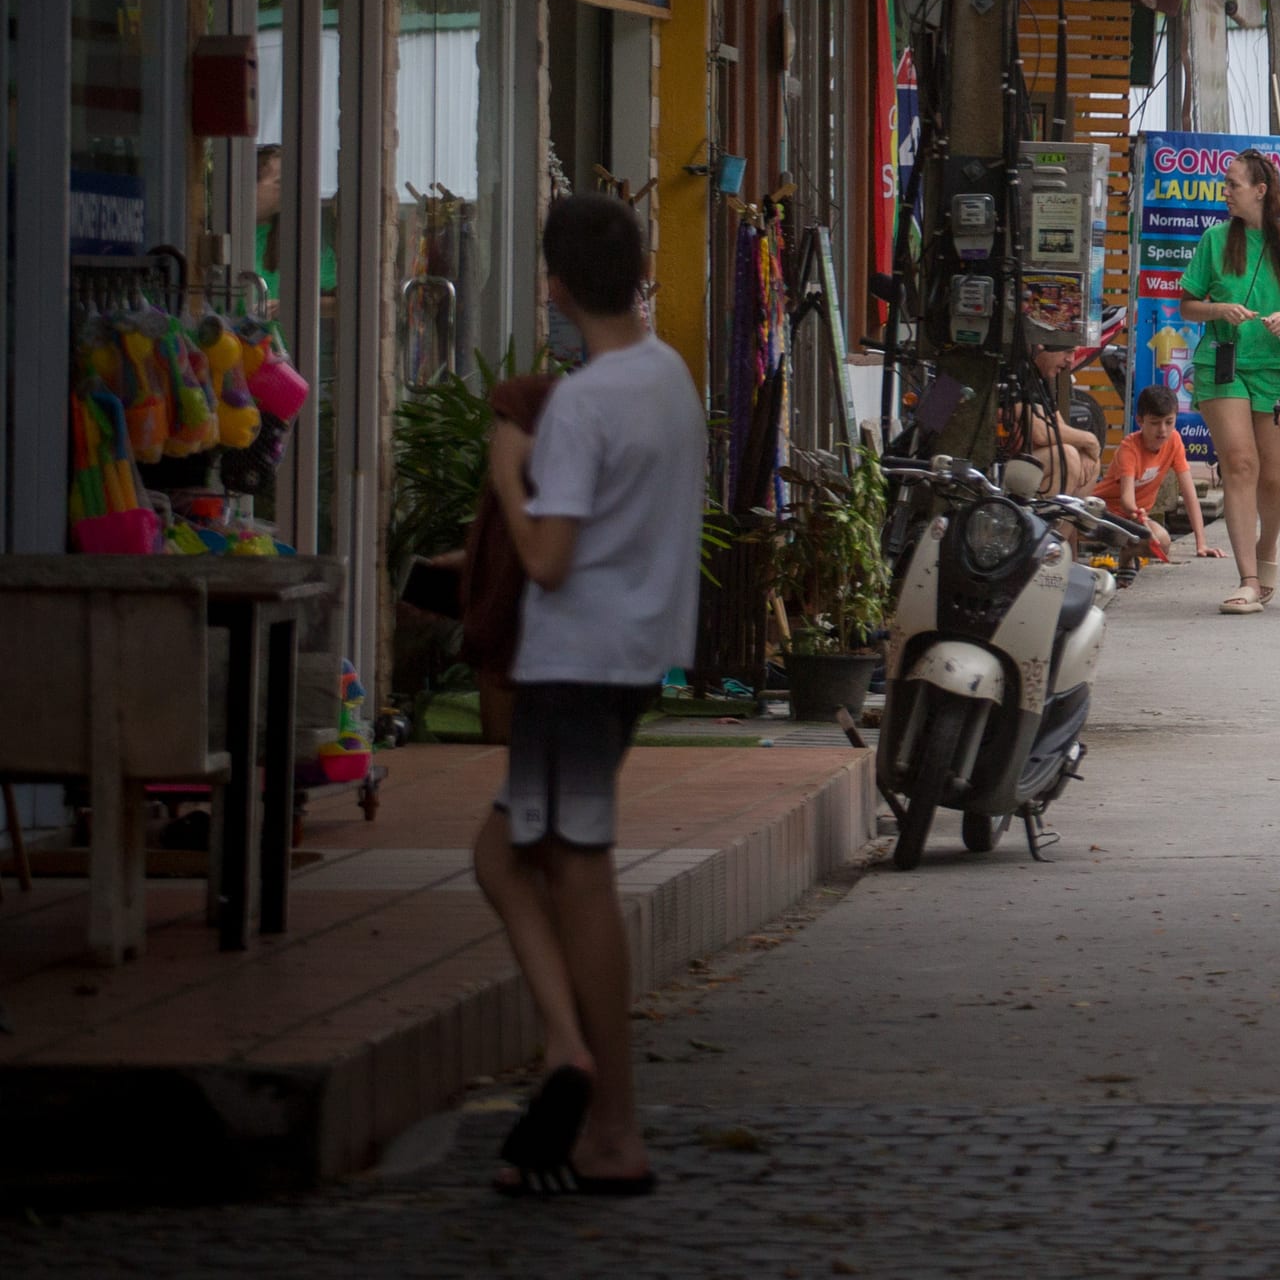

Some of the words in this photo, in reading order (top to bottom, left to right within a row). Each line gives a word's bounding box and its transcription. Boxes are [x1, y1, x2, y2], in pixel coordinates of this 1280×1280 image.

[1155, 179, 1228, 202] LAUN
[1149, 213, 1199, 228] Normal
[1181, 424, 1212, 437] deliv
